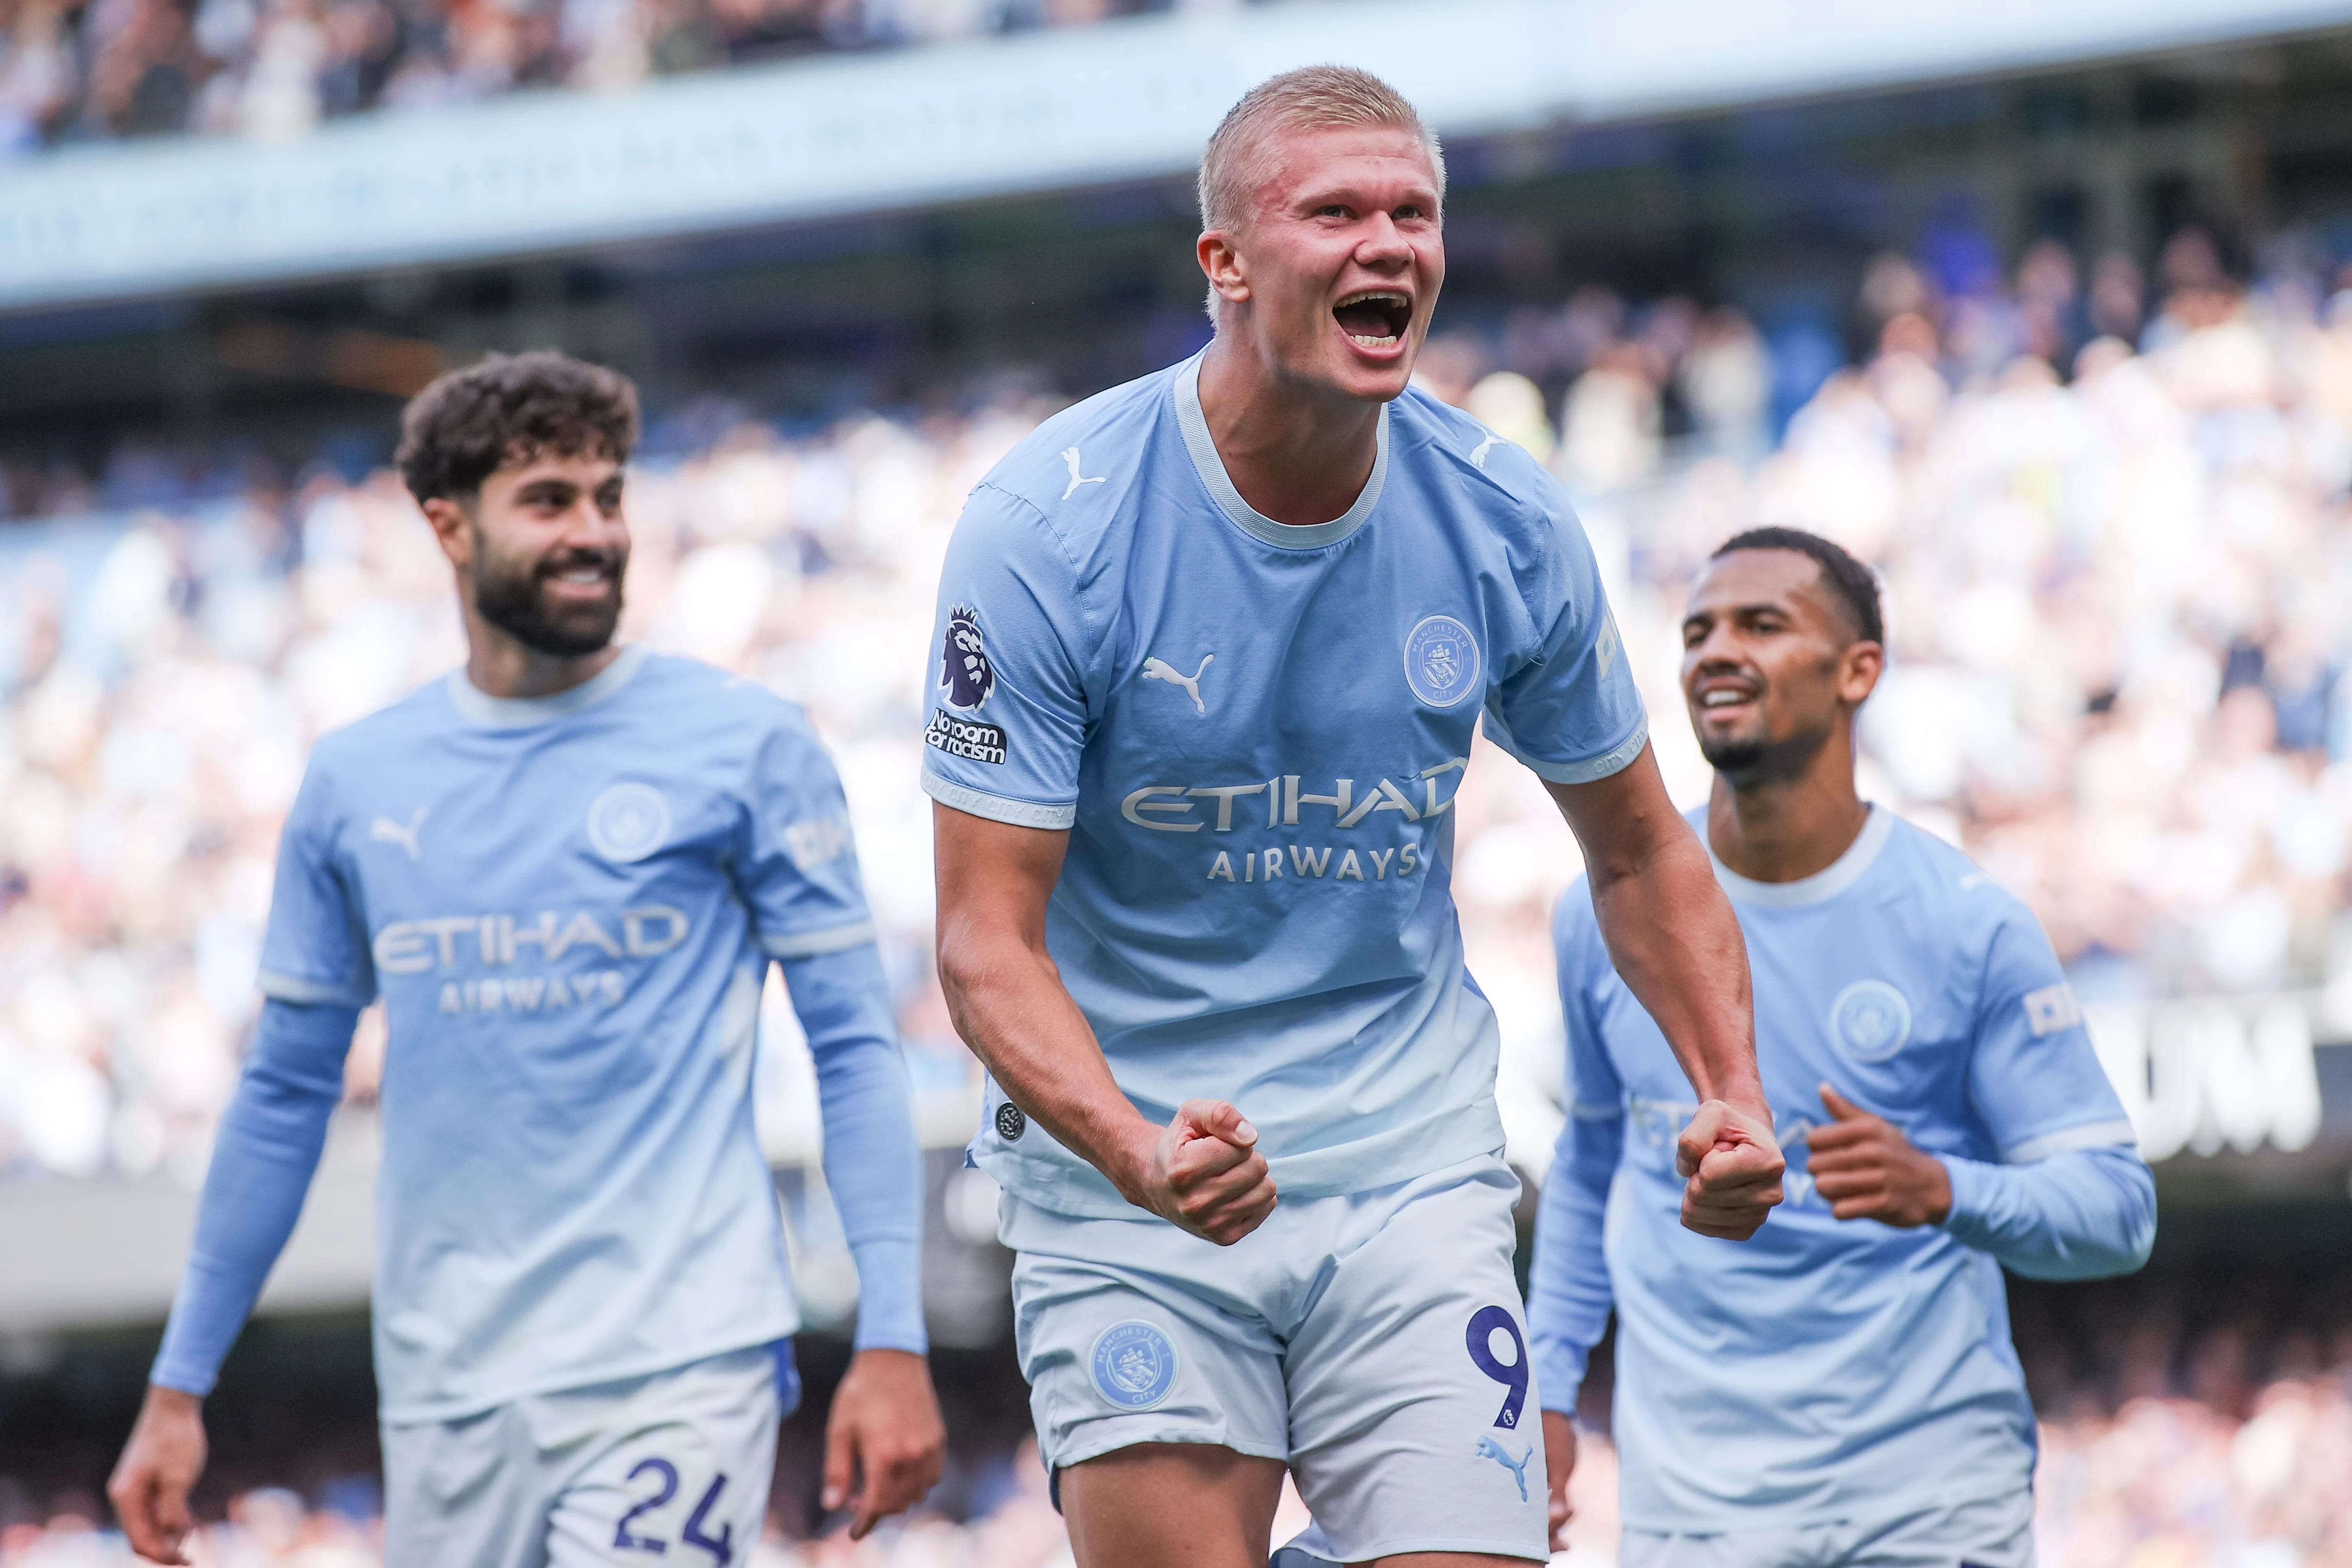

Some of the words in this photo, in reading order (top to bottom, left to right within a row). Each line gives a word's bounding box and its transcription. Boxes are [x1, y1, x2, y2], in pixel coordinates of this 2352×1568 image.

[1412, 625, 1468, 653] MANCHESTER
[1433, 690, 1454, 699] CITY
[924, 725, 947, 748] for
[945, 737, 1005, 764] racism
[929, 708, 950, 732] No
[951, 721, 999, 745] room
[1121, 756, 1468, 832] ETIHAD
[1207, 843, 1417, 883] AIRWAYS
[373, 904, 690, 974] ETIHAD
[440, 970, 624, 1013] AIRWAYS
[1097, 1327, 1163, 1364] MANCHESTER
[1466, 1305, 1529, 1430] 9
[1132, 1390, 1156, 1404] CITY
[613, 1458, 734, 1568] 24
